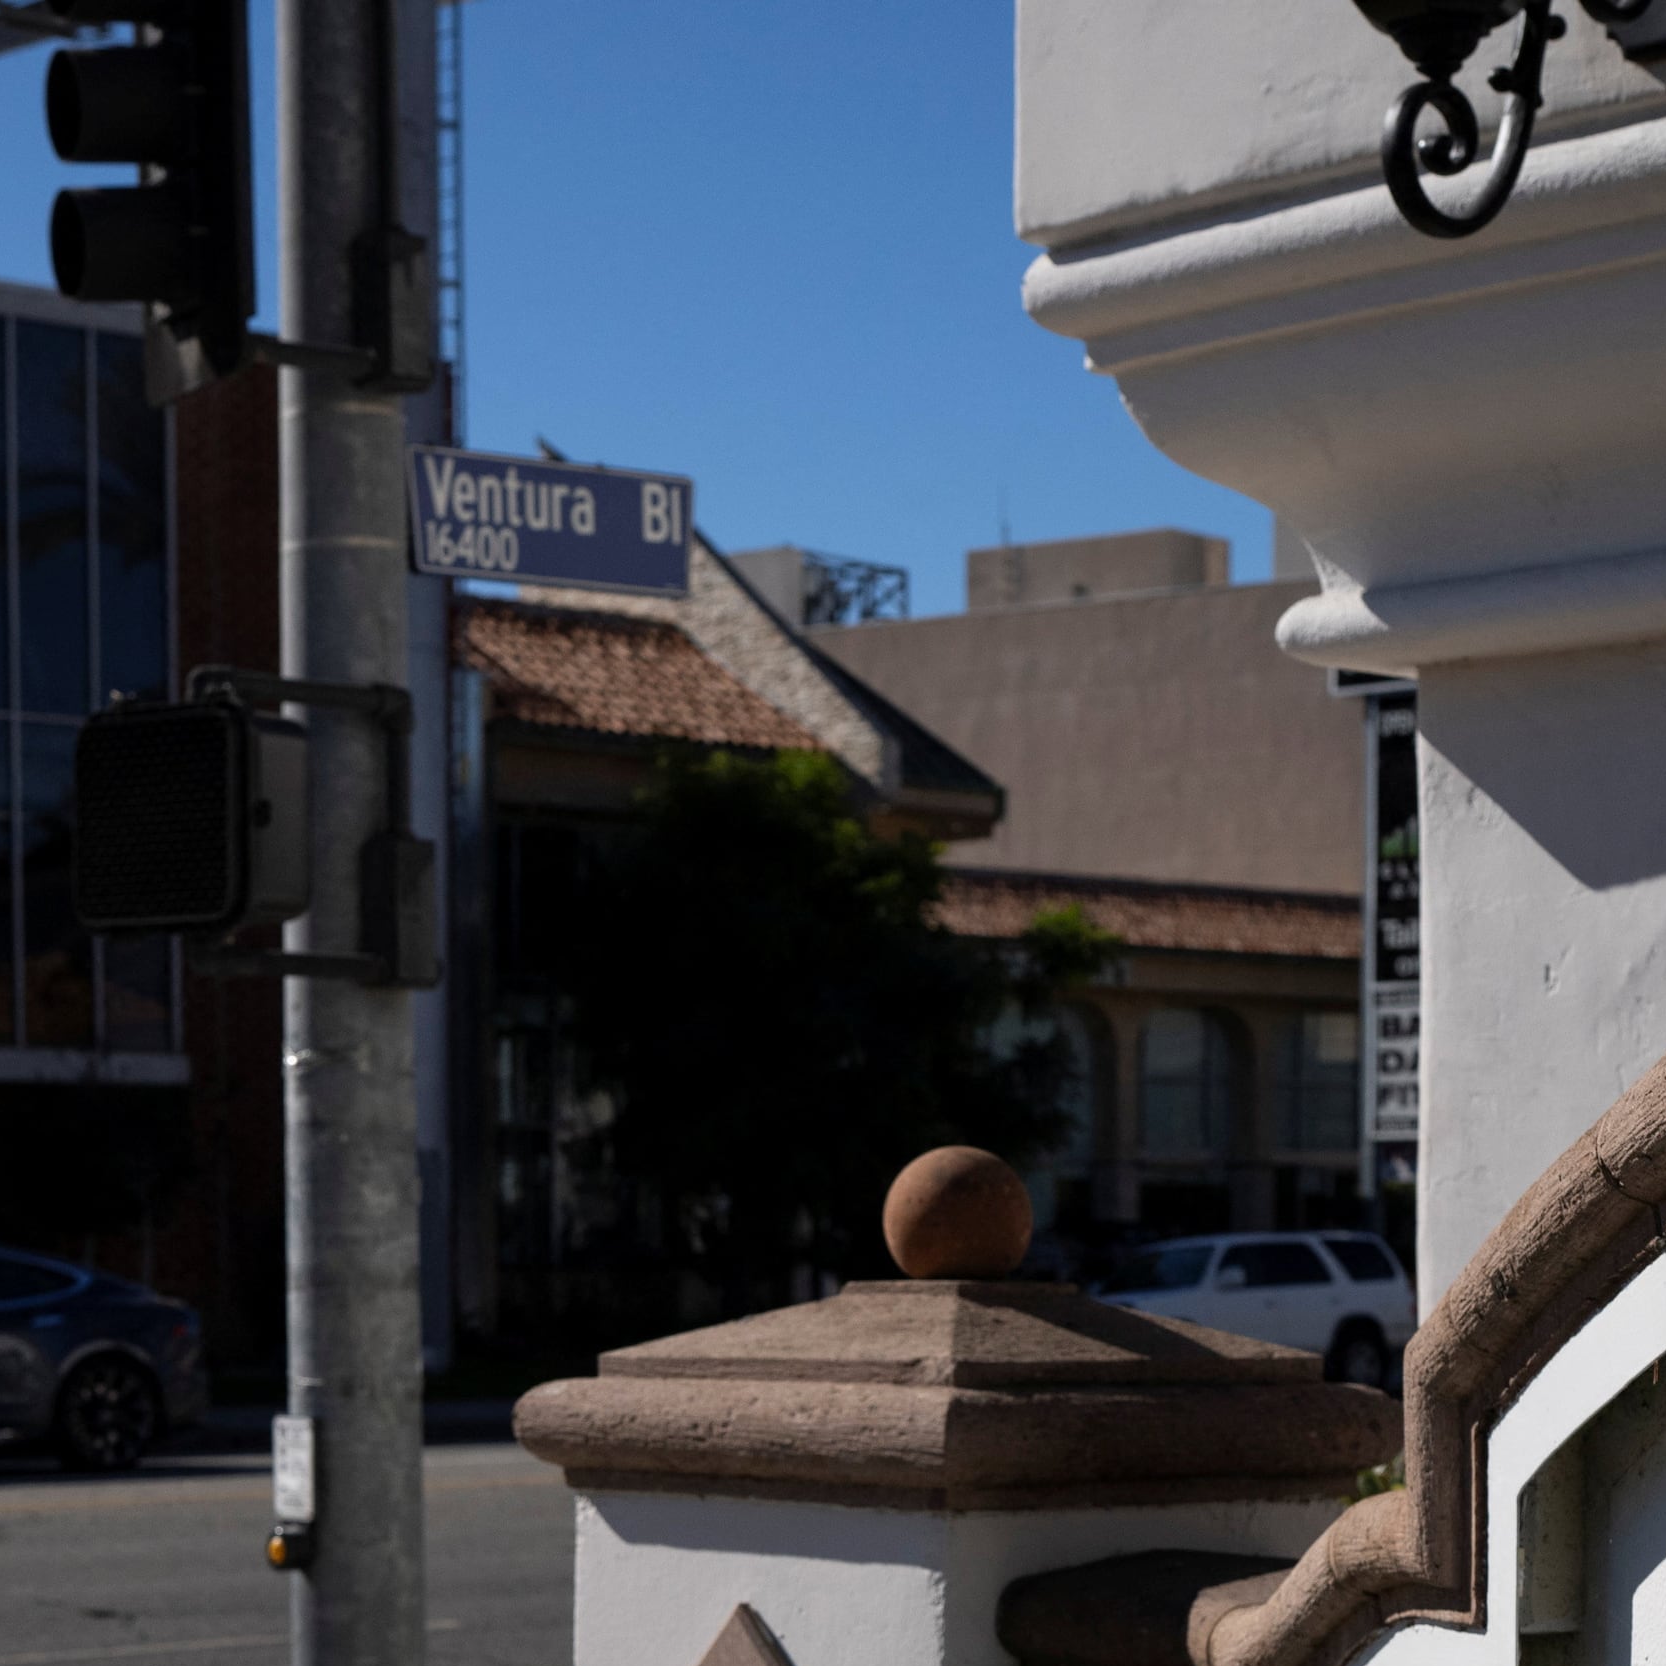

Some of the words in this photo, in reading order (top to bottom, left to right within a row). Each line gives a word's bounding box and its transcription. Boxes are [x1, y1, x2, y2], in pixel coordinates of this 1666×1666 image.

[423, 455, 597, 536] Ventura
[640, 481, 683, 545] Bl
[424, 520, 520, 572] 16400
